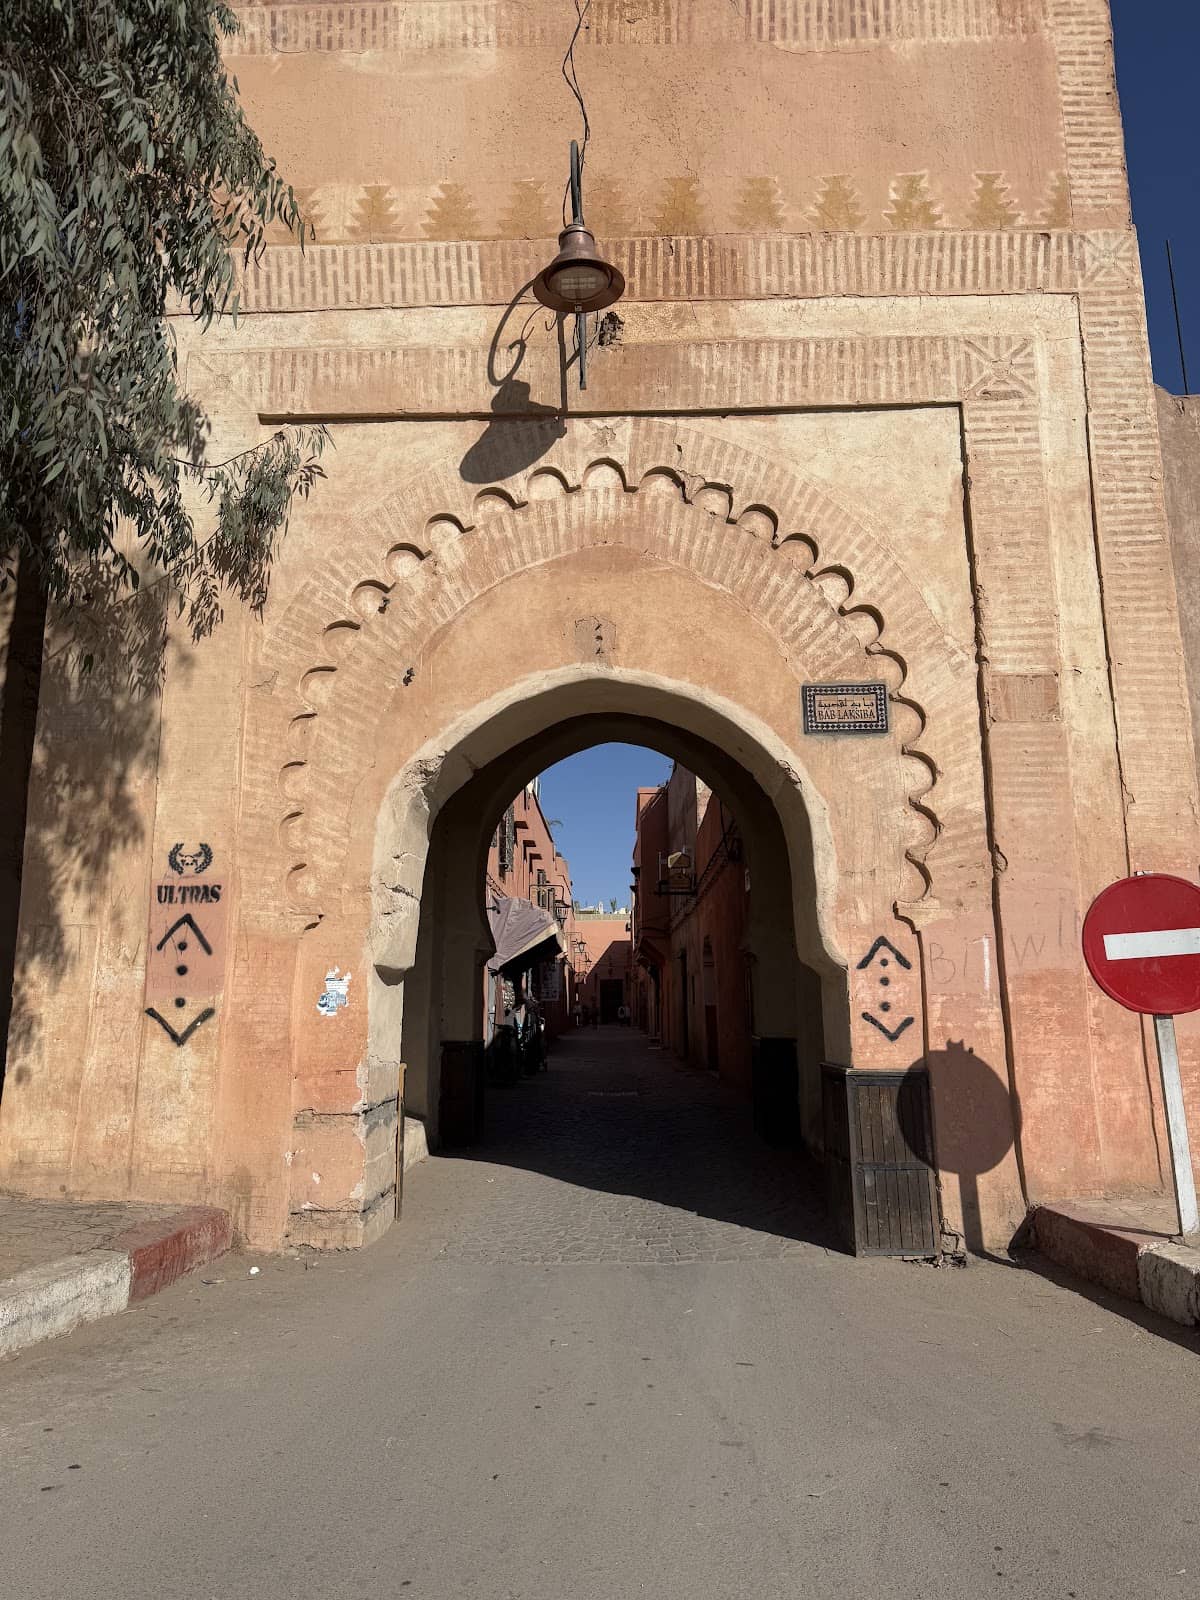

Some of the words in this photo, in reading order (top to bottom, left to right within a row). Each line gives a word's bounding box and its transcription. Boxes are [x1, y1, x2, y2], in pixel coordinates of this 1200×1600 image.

[818, 709, 835, 720] BAB
[838, 709, 875, 719] LAKSIBA
[157, 884, 222, 904] ULTRAS
